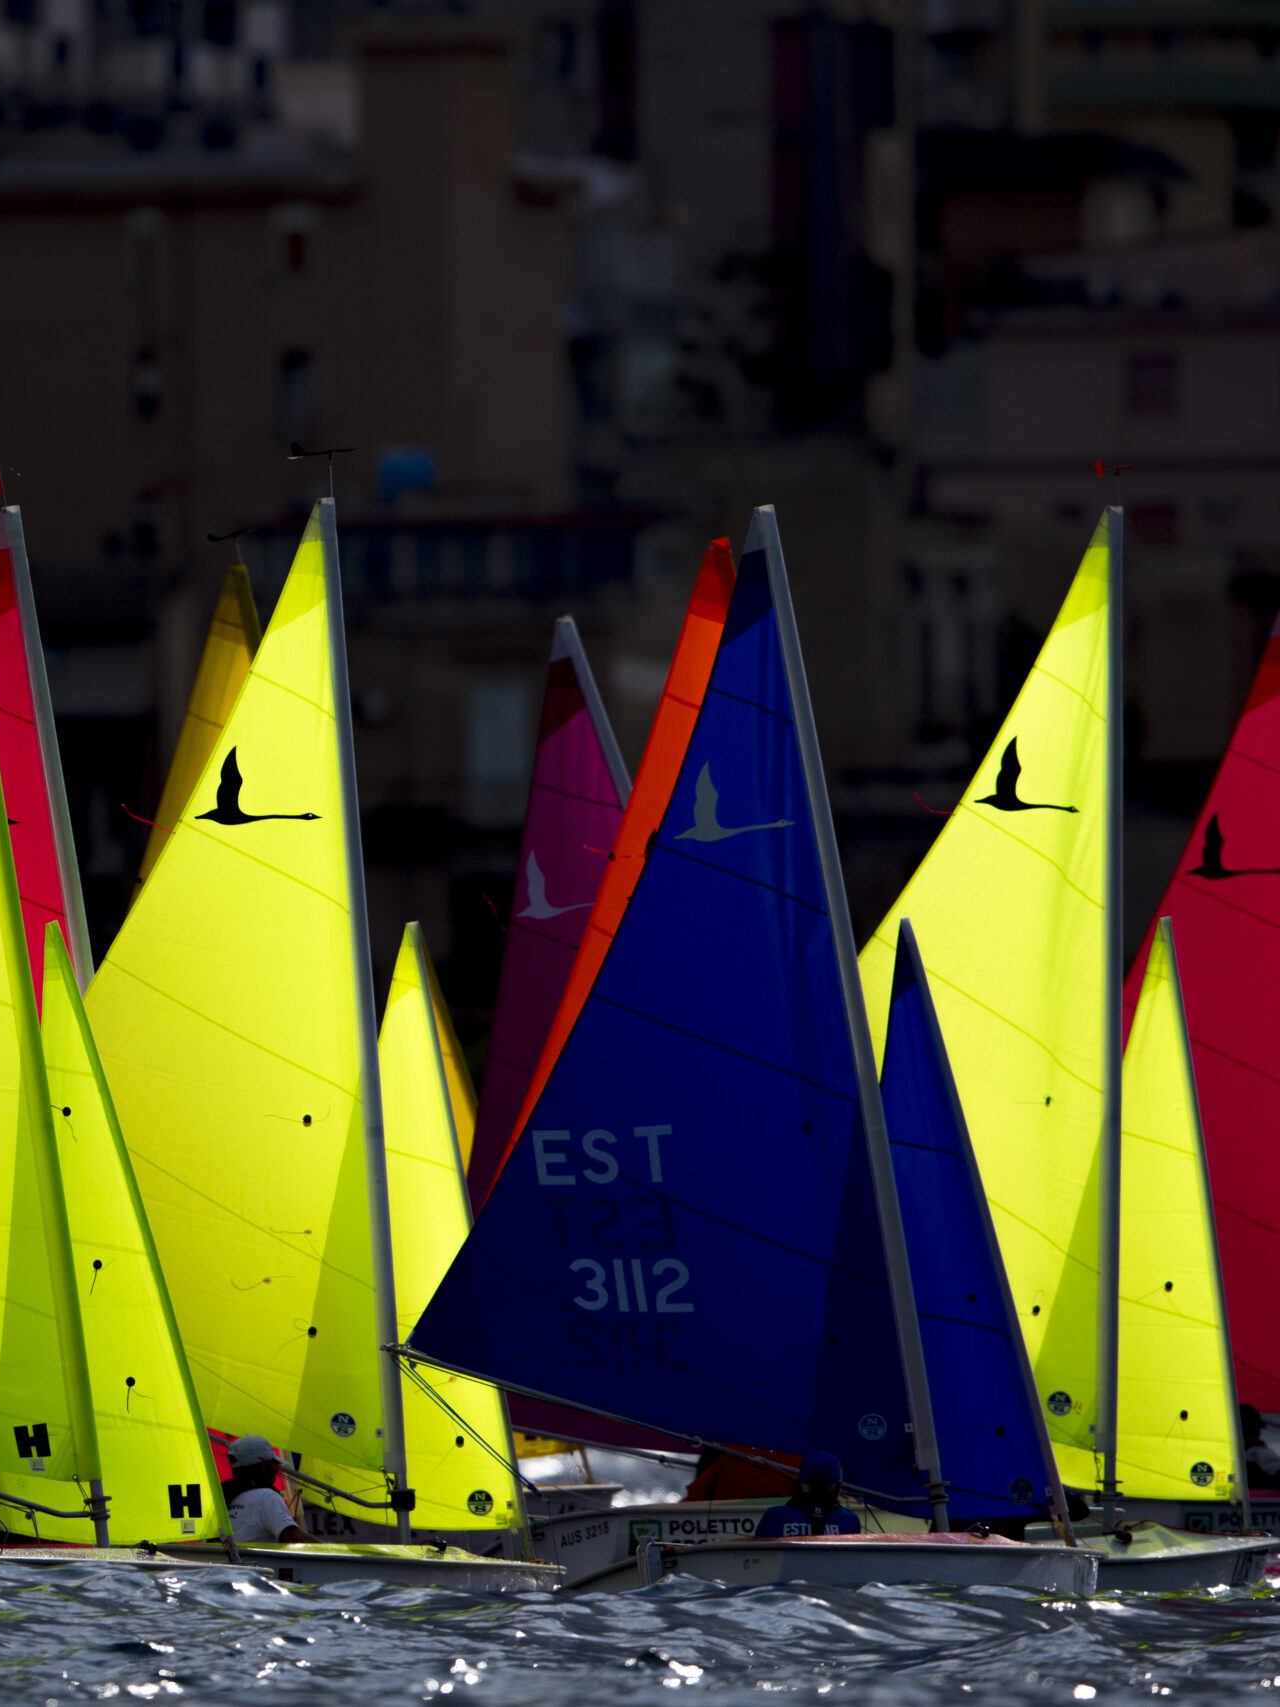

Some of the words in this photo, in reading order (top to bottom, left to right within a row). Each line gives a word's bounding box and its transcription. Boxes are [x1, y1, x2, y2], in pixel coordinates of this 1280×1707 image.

[531, 1123, 673, 1187] EST
[567, 1256, 695, 1314] 3112
[669, 1517, 755, 1535] POLETTO
[1219, 1511, 1280, 1526] POETT
[560, 1529, 583, 1548] AUS
